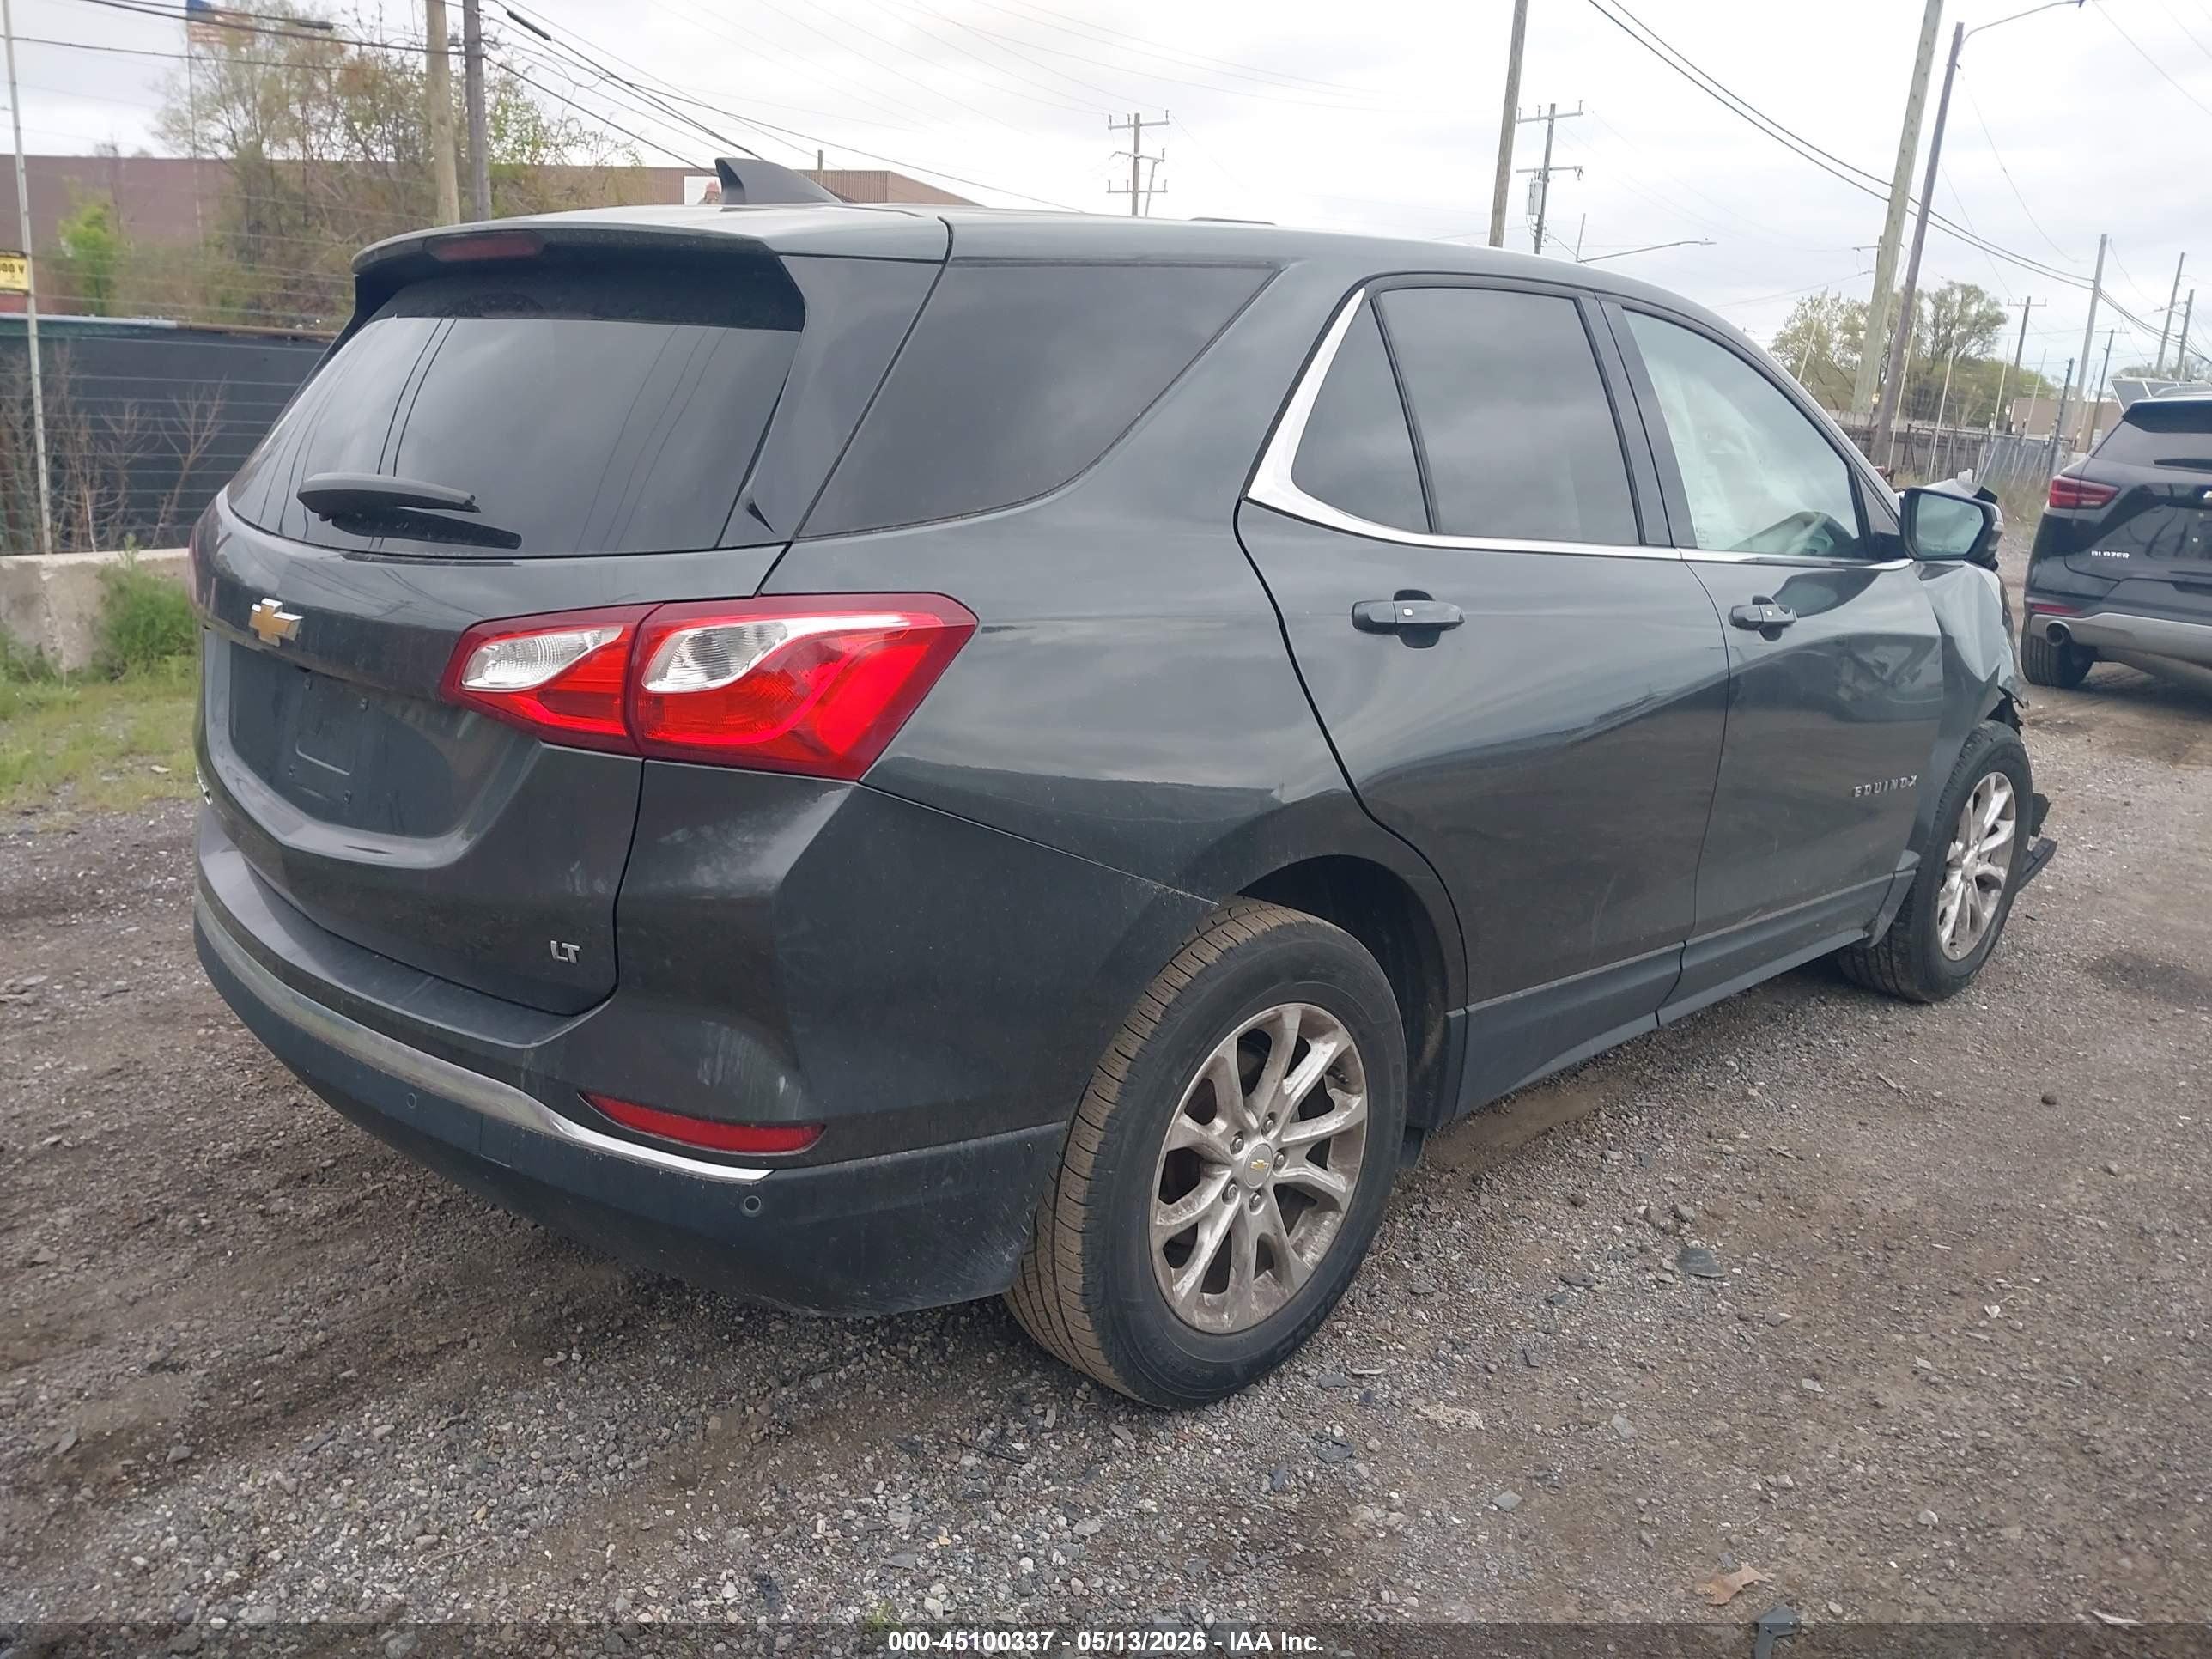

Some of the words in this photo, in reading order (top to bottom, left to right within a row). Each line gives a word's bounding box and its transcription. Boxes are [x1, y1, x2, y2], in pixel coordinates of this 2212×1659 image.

[2091, 550, 2130, 559] BLAZER
[1854, 775, 1917, 798] EQUINOX
[550, 939, 580, 964] LT
